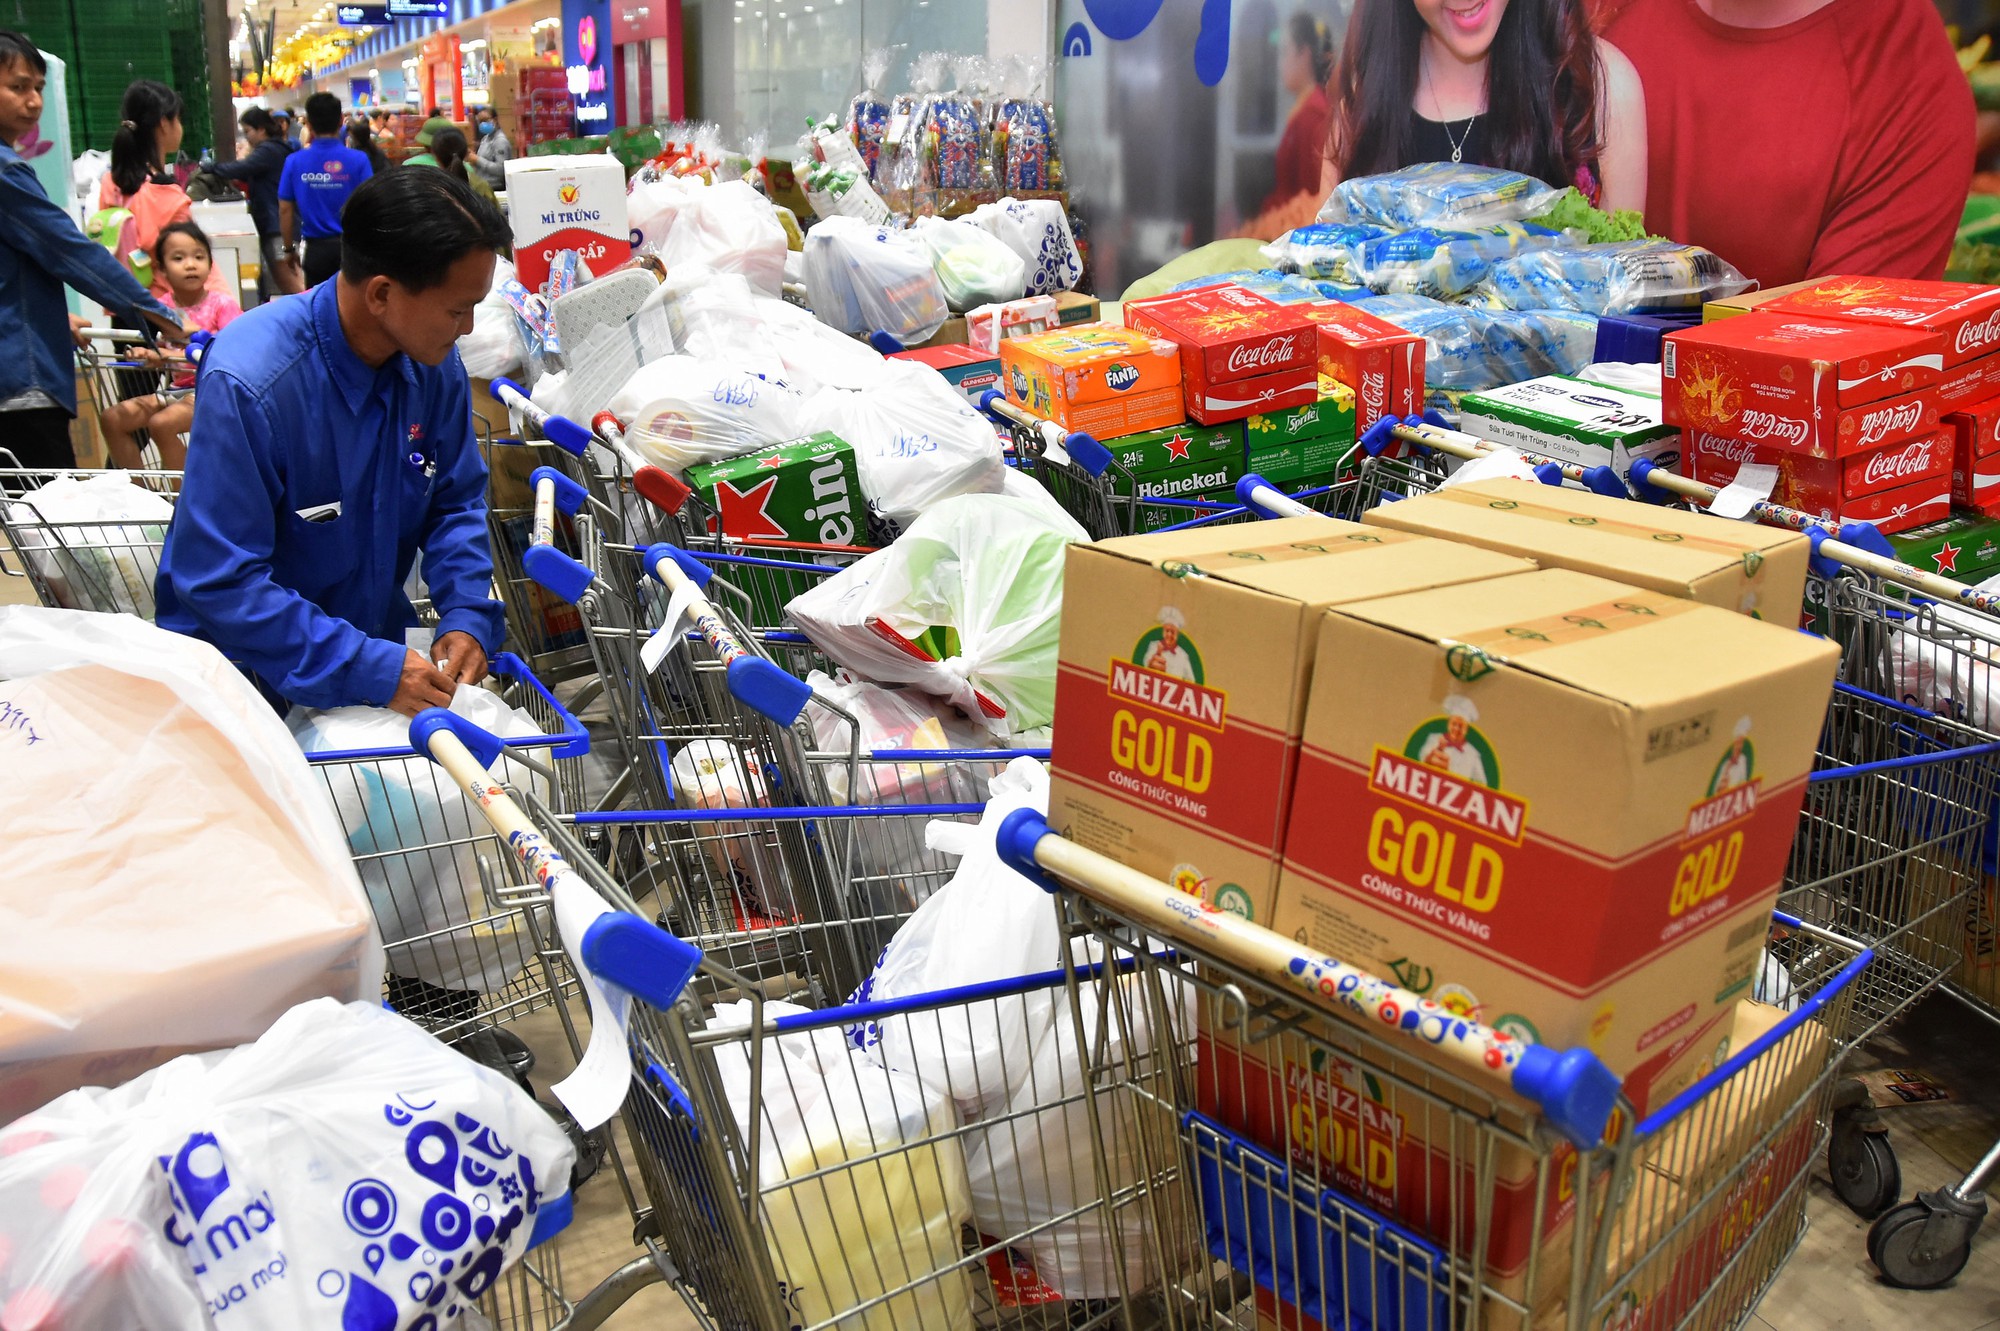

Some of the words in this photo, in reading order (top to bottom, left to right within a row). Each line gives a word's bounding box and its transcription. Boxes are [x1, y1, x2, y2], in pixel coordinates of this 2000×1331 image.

[541, 211, 555, 224] MÌ
[558, 208, 600, 222] TRỨNG
[577, 241, 606, 258] CẤP
[1228, 334, 1297, 372] Coca-Cola
[1955, 308, 2000, 354] Coca-Co
[1012, 371, 1028, 391] FANTA
[1106, 365, 1139, 387] FANTA
[1289, 409, 1317, 432] Sprite
[1488, 423, 1500, 434] Sữa
[1501, 427, 1515, 438] Tươi
[1516, 430, 1528, 442] Tiệt
[1529, 434, 1548, 450] Trùng
[1553, 442, 1561, 450] Có
[1562, 444, 1580, 457] Đường
[1738, 409, 1809, 446] Coca-Cola
[1857, 400, 1923, 446] Coca-Cola
[1123, 451, 1136, 464] 24
[1864, 439, 1935, 485] Coca-Cola
[1112, 665, 1223, 724] MEIZAN
[1111, 709, 1213, 794] GOLD
[1108, 770, 1139, 792] CÔNG
[1141, 781, 1173, 805] THỨC
[1174, 793, 1207, 818] VÀNG
[1375, 756, 1522, 837] MEIZAN
[1686, 783, 1759, 838] MEIZAN
[1368, 806, 1504, 914] GOLD
[1668, 830, 1744, 917] GOLD
[1361, 873, 1402, 901] CÔNG
[1404, 891, 1445, 920] THỨC
[1447, 908, 1490, 940] VÀNG
[1291, 1102, 1395, 1190] GOLD
